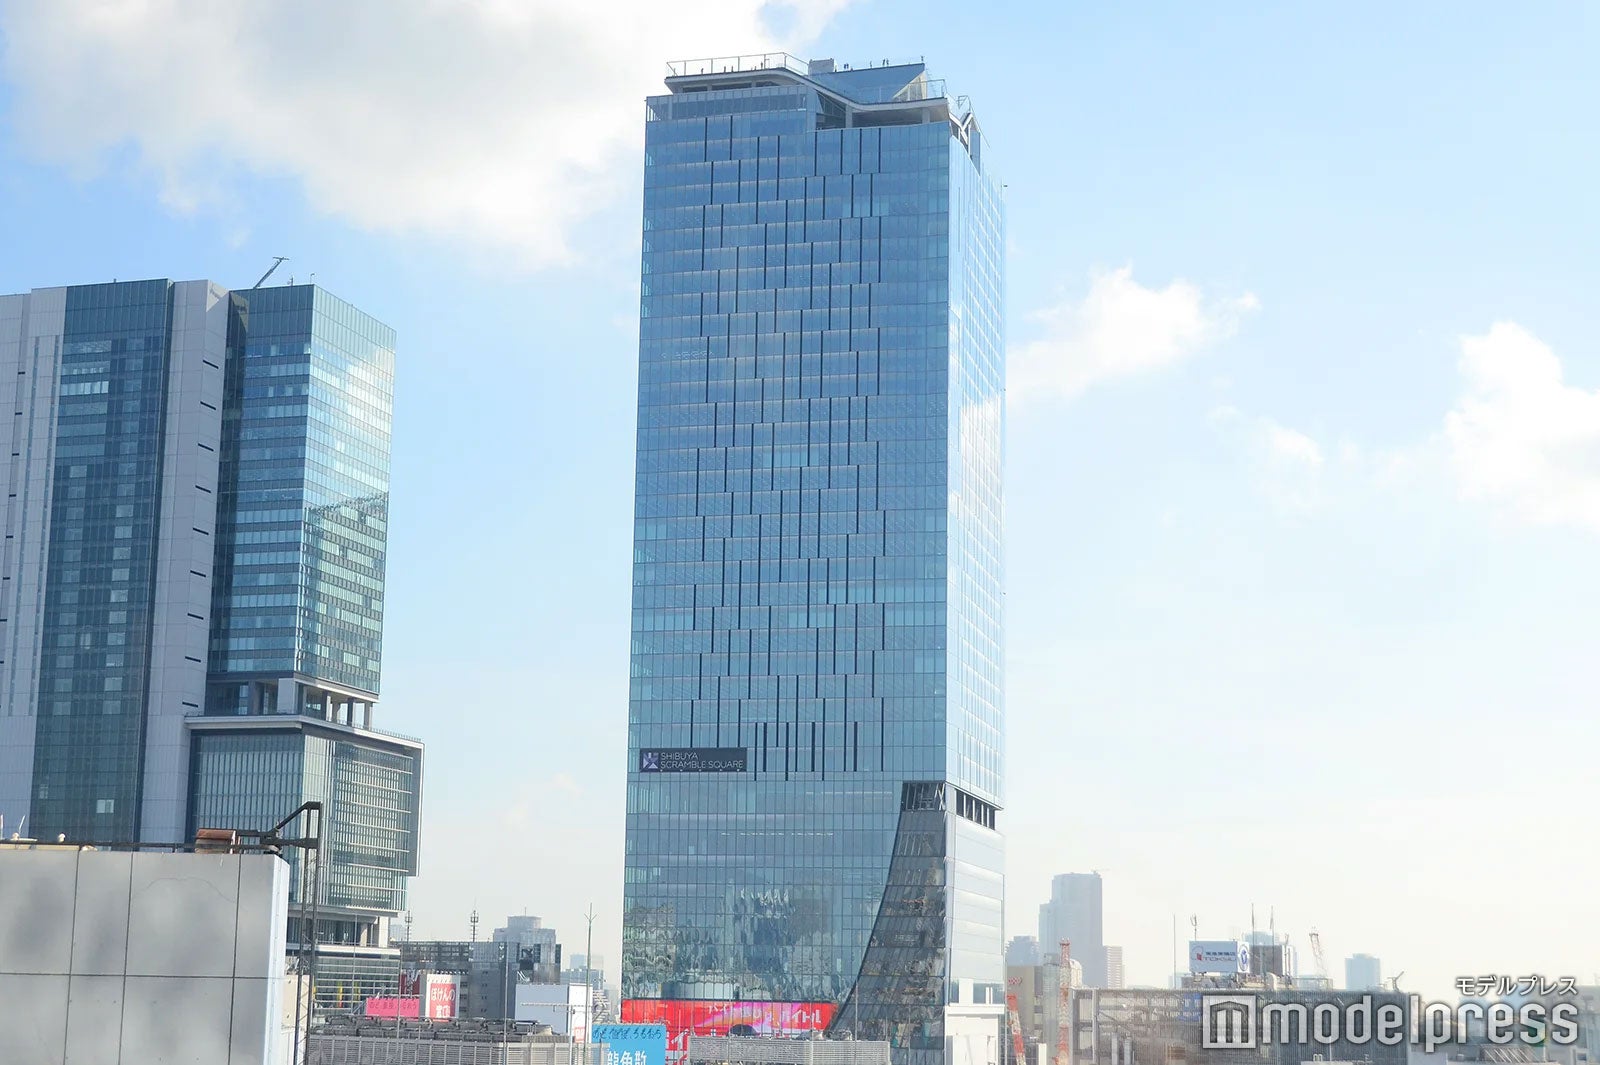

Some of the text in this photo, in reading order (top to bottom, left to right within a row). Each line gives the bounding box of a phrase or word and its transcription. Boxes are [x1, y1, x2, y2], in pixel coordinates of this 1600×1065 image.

[660, 752, 698, 760] SHIBUYA
[660, 760, 743, 769] SCRAMBLE SQUARE
[431, 987, 455, 1001] ほけんの
